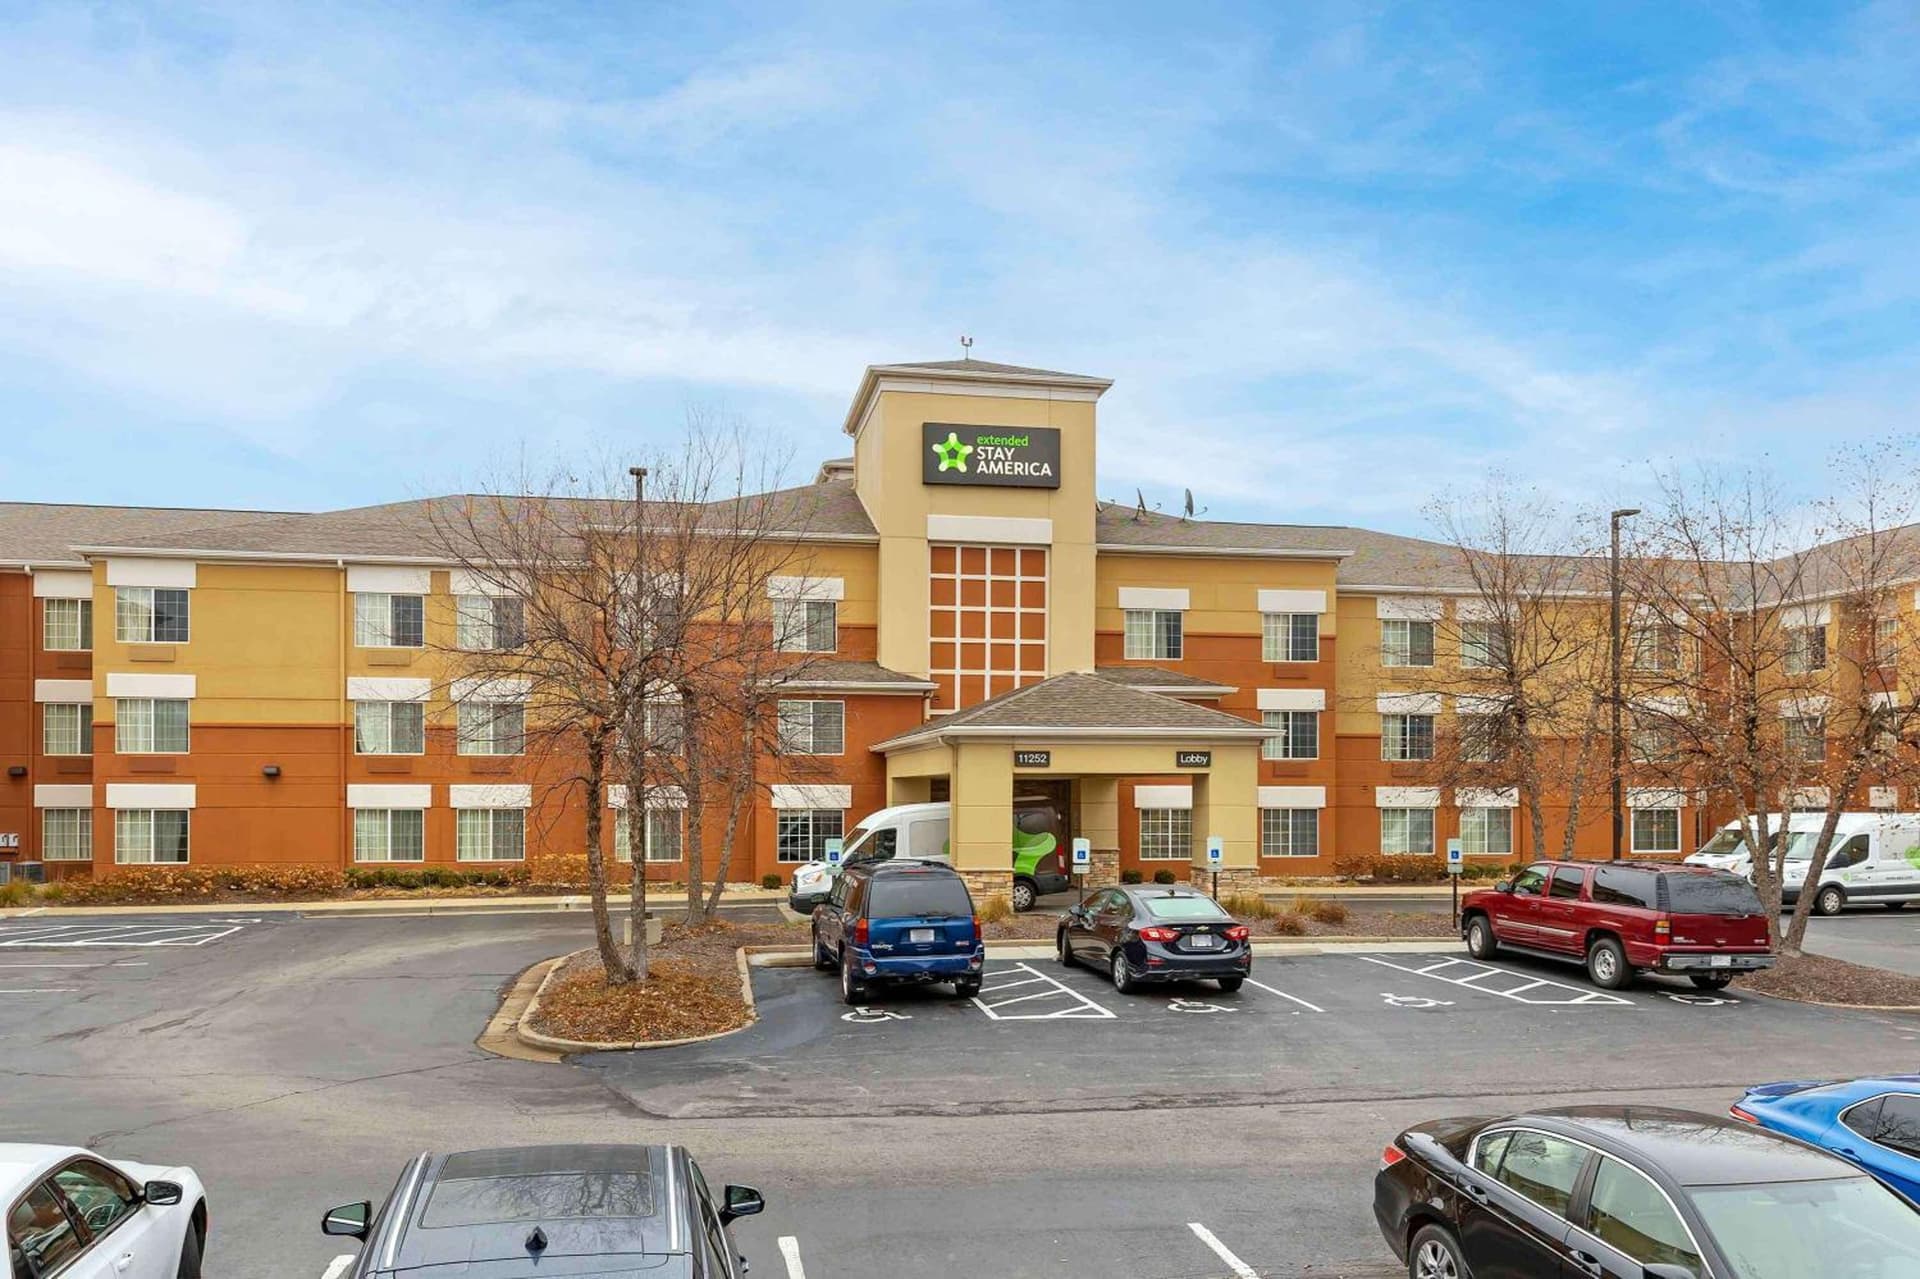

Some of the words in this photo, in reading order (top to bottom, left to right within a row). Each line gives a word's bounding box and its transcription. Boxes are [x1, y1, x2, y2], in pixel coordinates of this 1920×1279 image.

[977, 435, 1029, 446] extended
[977, 447, 1015, 460] STAY
[976, 461, 1053, 476] AMERICA
[1018, 753, 1047, 763] 11252
[1180, 753, 1208, 764] Lobby
